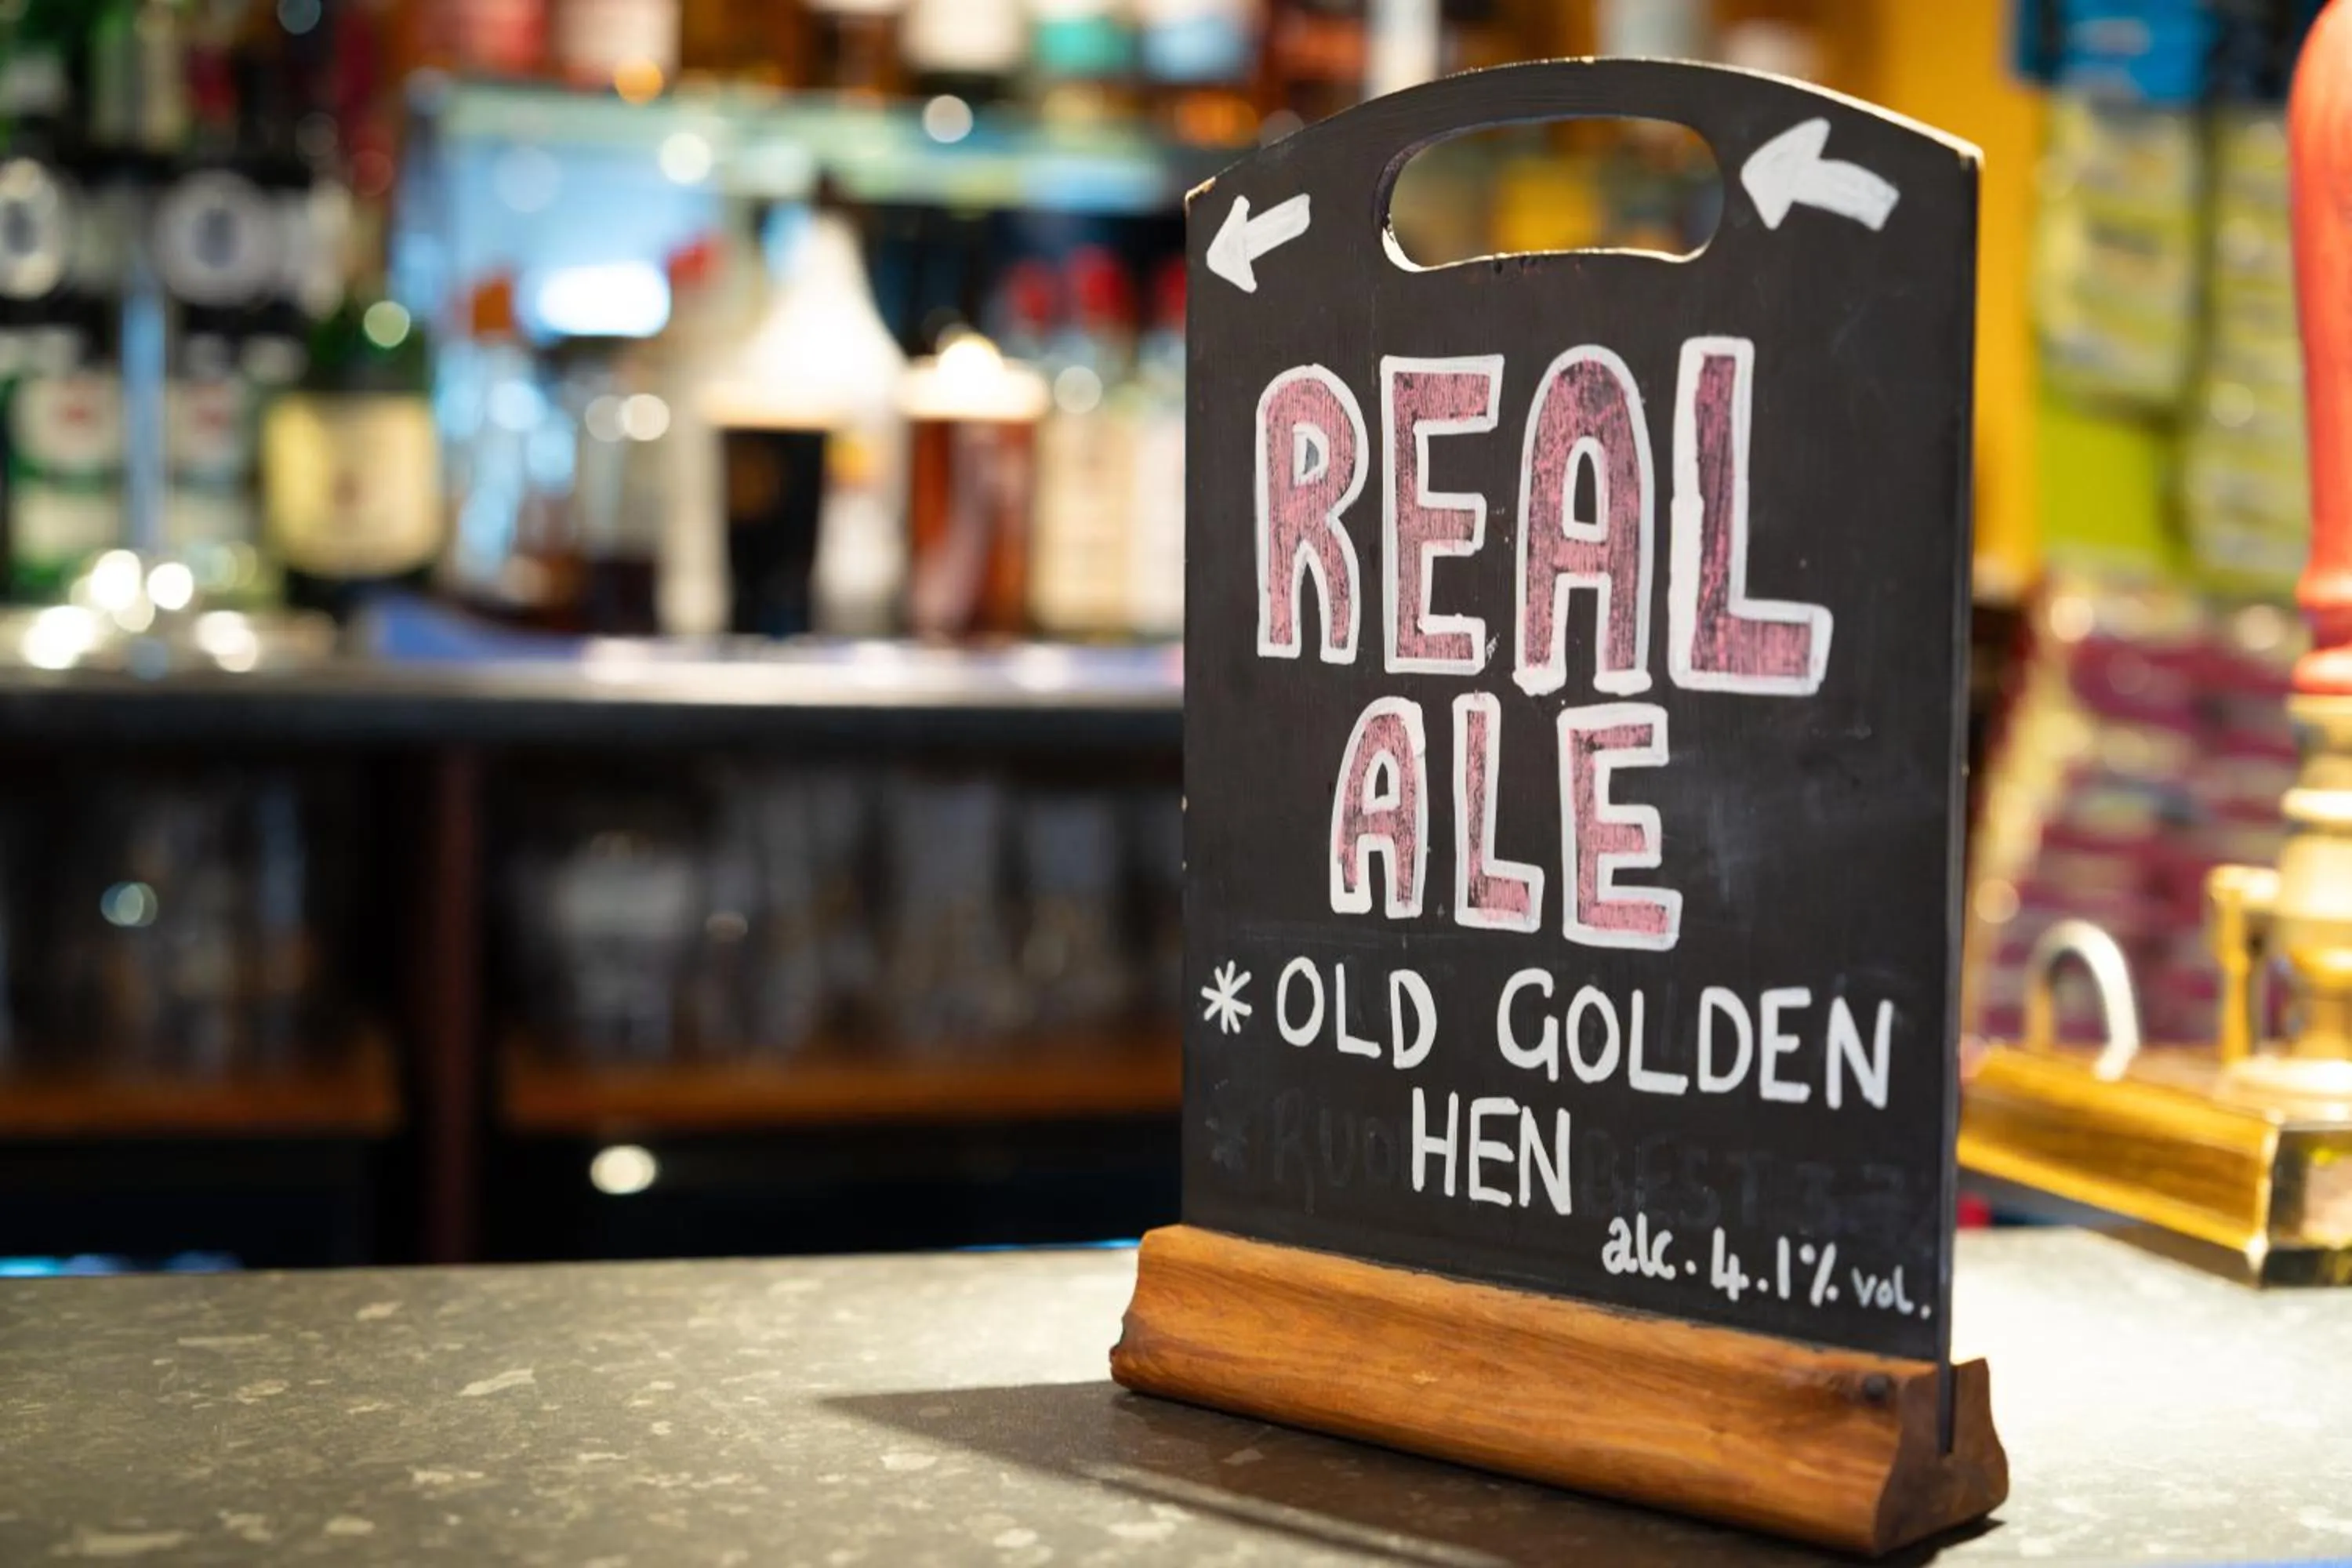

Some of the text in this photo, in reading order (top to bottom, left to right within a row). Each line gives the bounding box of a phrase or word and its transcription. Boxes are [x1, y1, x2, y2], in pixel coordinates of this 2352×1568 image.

[1254, 335, 1834, 697] REAL
[1330, 690, 1683, 952] ALE
[1276, 956, 1893, 1109] OLD GOLDEN
[1411, 1087, 1572, 1215] HEN
[1850, 1264, 1932, 1320] vol.
